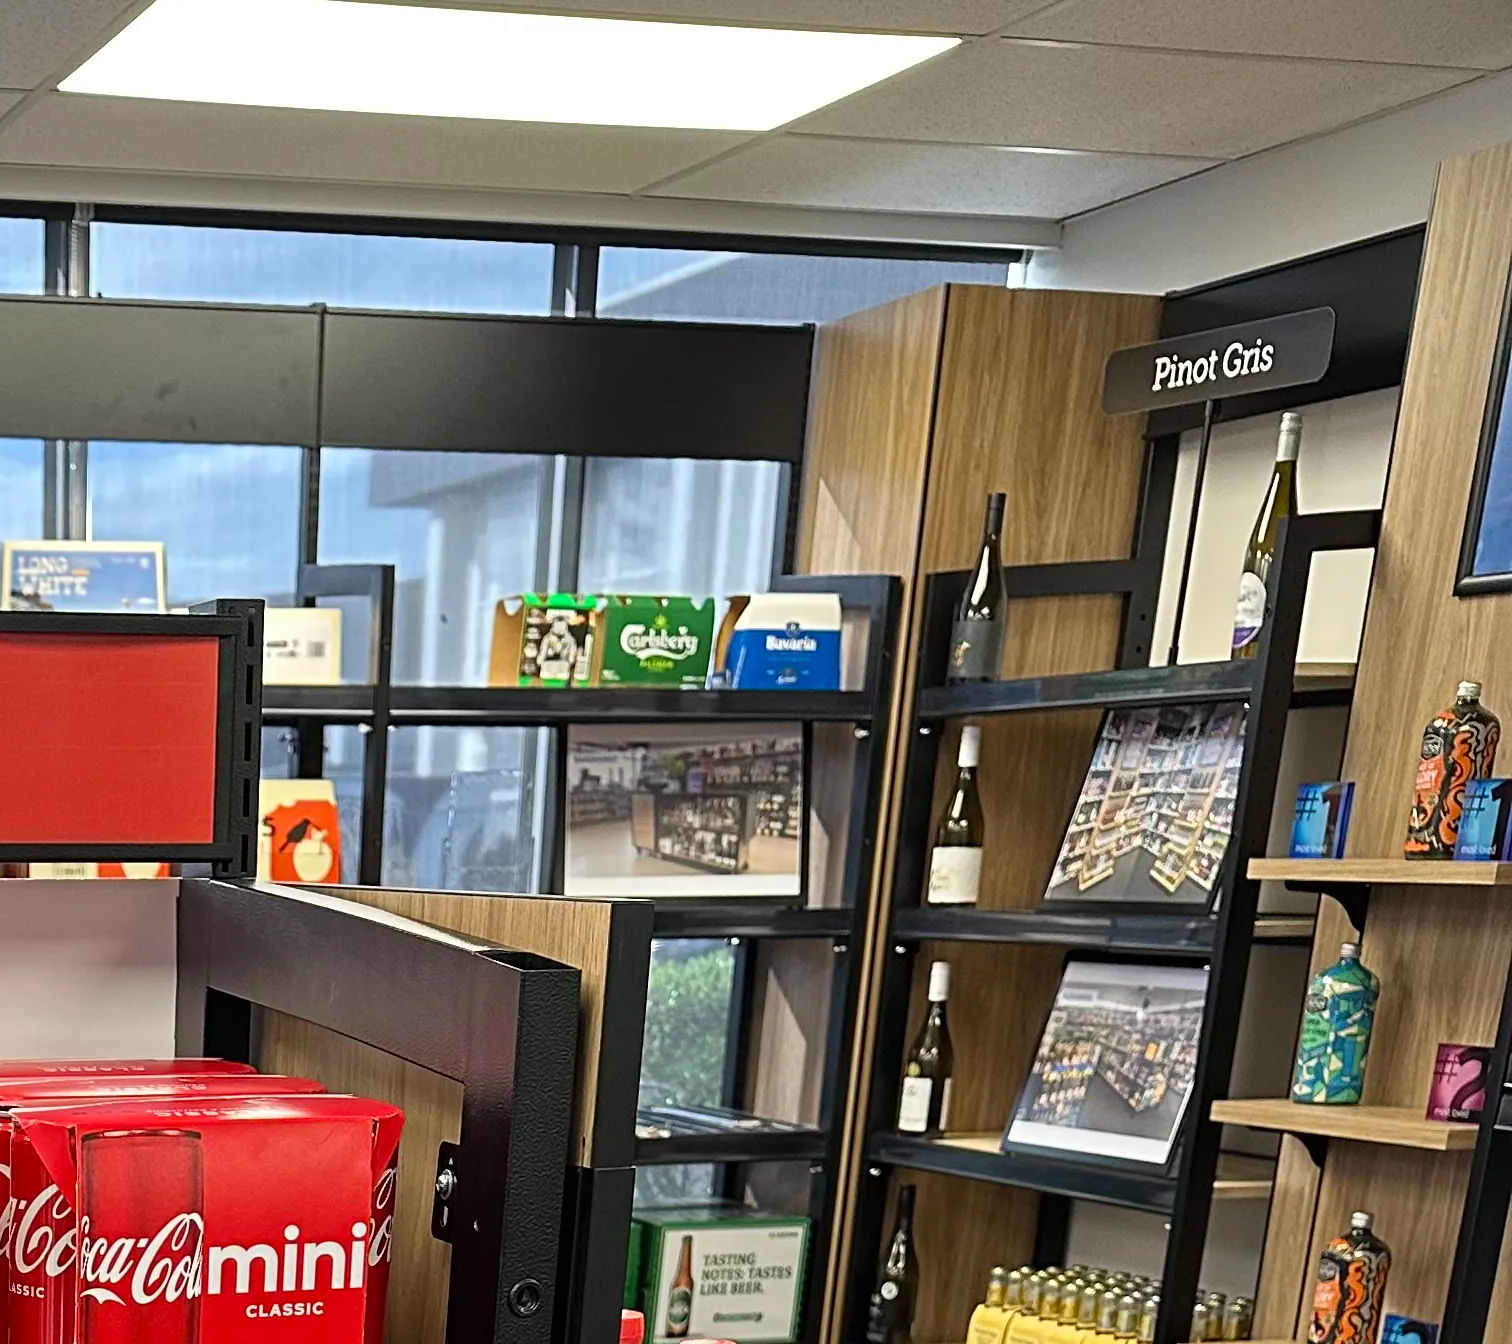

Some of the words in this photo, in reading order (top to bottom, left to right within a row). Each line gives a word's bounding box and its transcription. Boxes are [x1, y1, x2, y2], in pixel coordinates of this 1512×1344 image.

[1152, 350, 1218, 392] Pinot
[1222, 338, 1274, 378] Gris
[620, 624, 699, 657] Carlsberg
[206, 1224, 367, 1295] mini
[704, 1252, 756, 1266] TASTING
[748, 1266, 792, 1278] TASTES
[700, 1283, 726, 1296] LIKE
[730, 1282, 764, 1294] BEER.
[246, 1302, 324, 1318] CLASSIC
